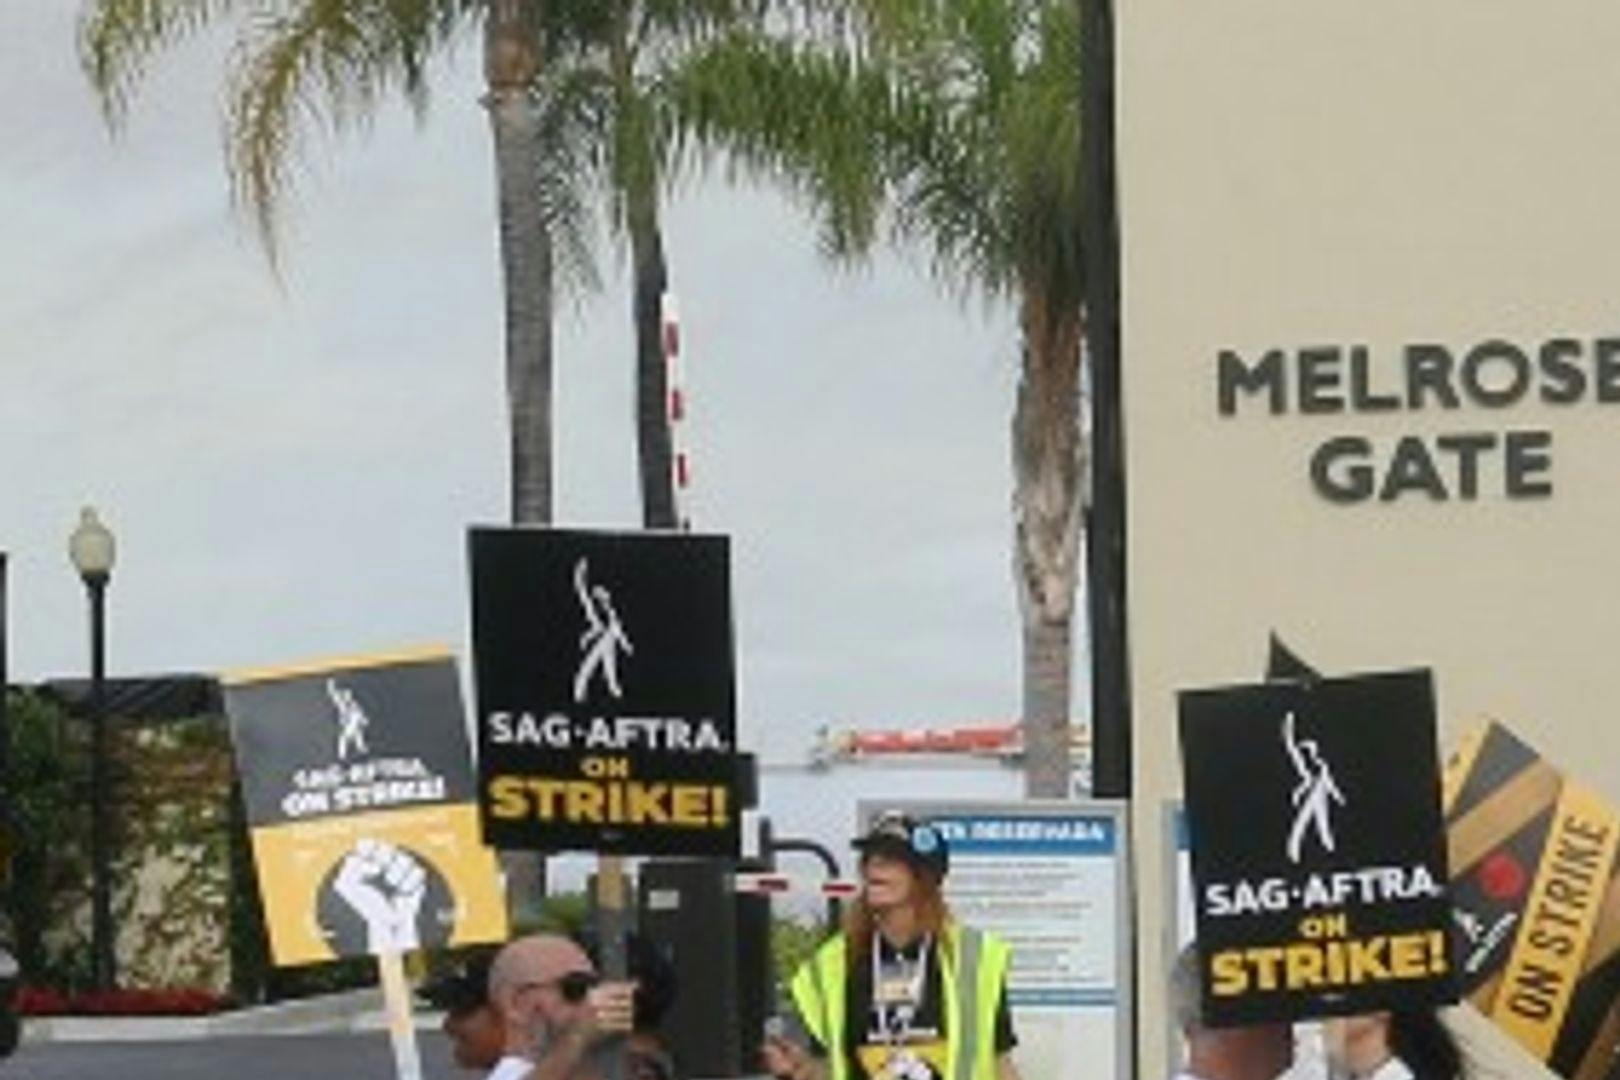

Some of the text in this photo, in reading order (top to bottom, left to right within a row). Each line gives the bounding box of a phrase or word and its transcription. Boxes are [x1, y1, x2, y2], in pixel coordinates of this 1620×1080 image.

[1309, 431, 1552, 504] GATE
[581, 756, 629, 777] ON
[490, 775, 728, 827] STRIKE!
[1299, 912, 1347, 938] ON
[1510, 816, 1611, 1022] ON STRIKE
[1211, 930, 1448, 996] STRIKE!
